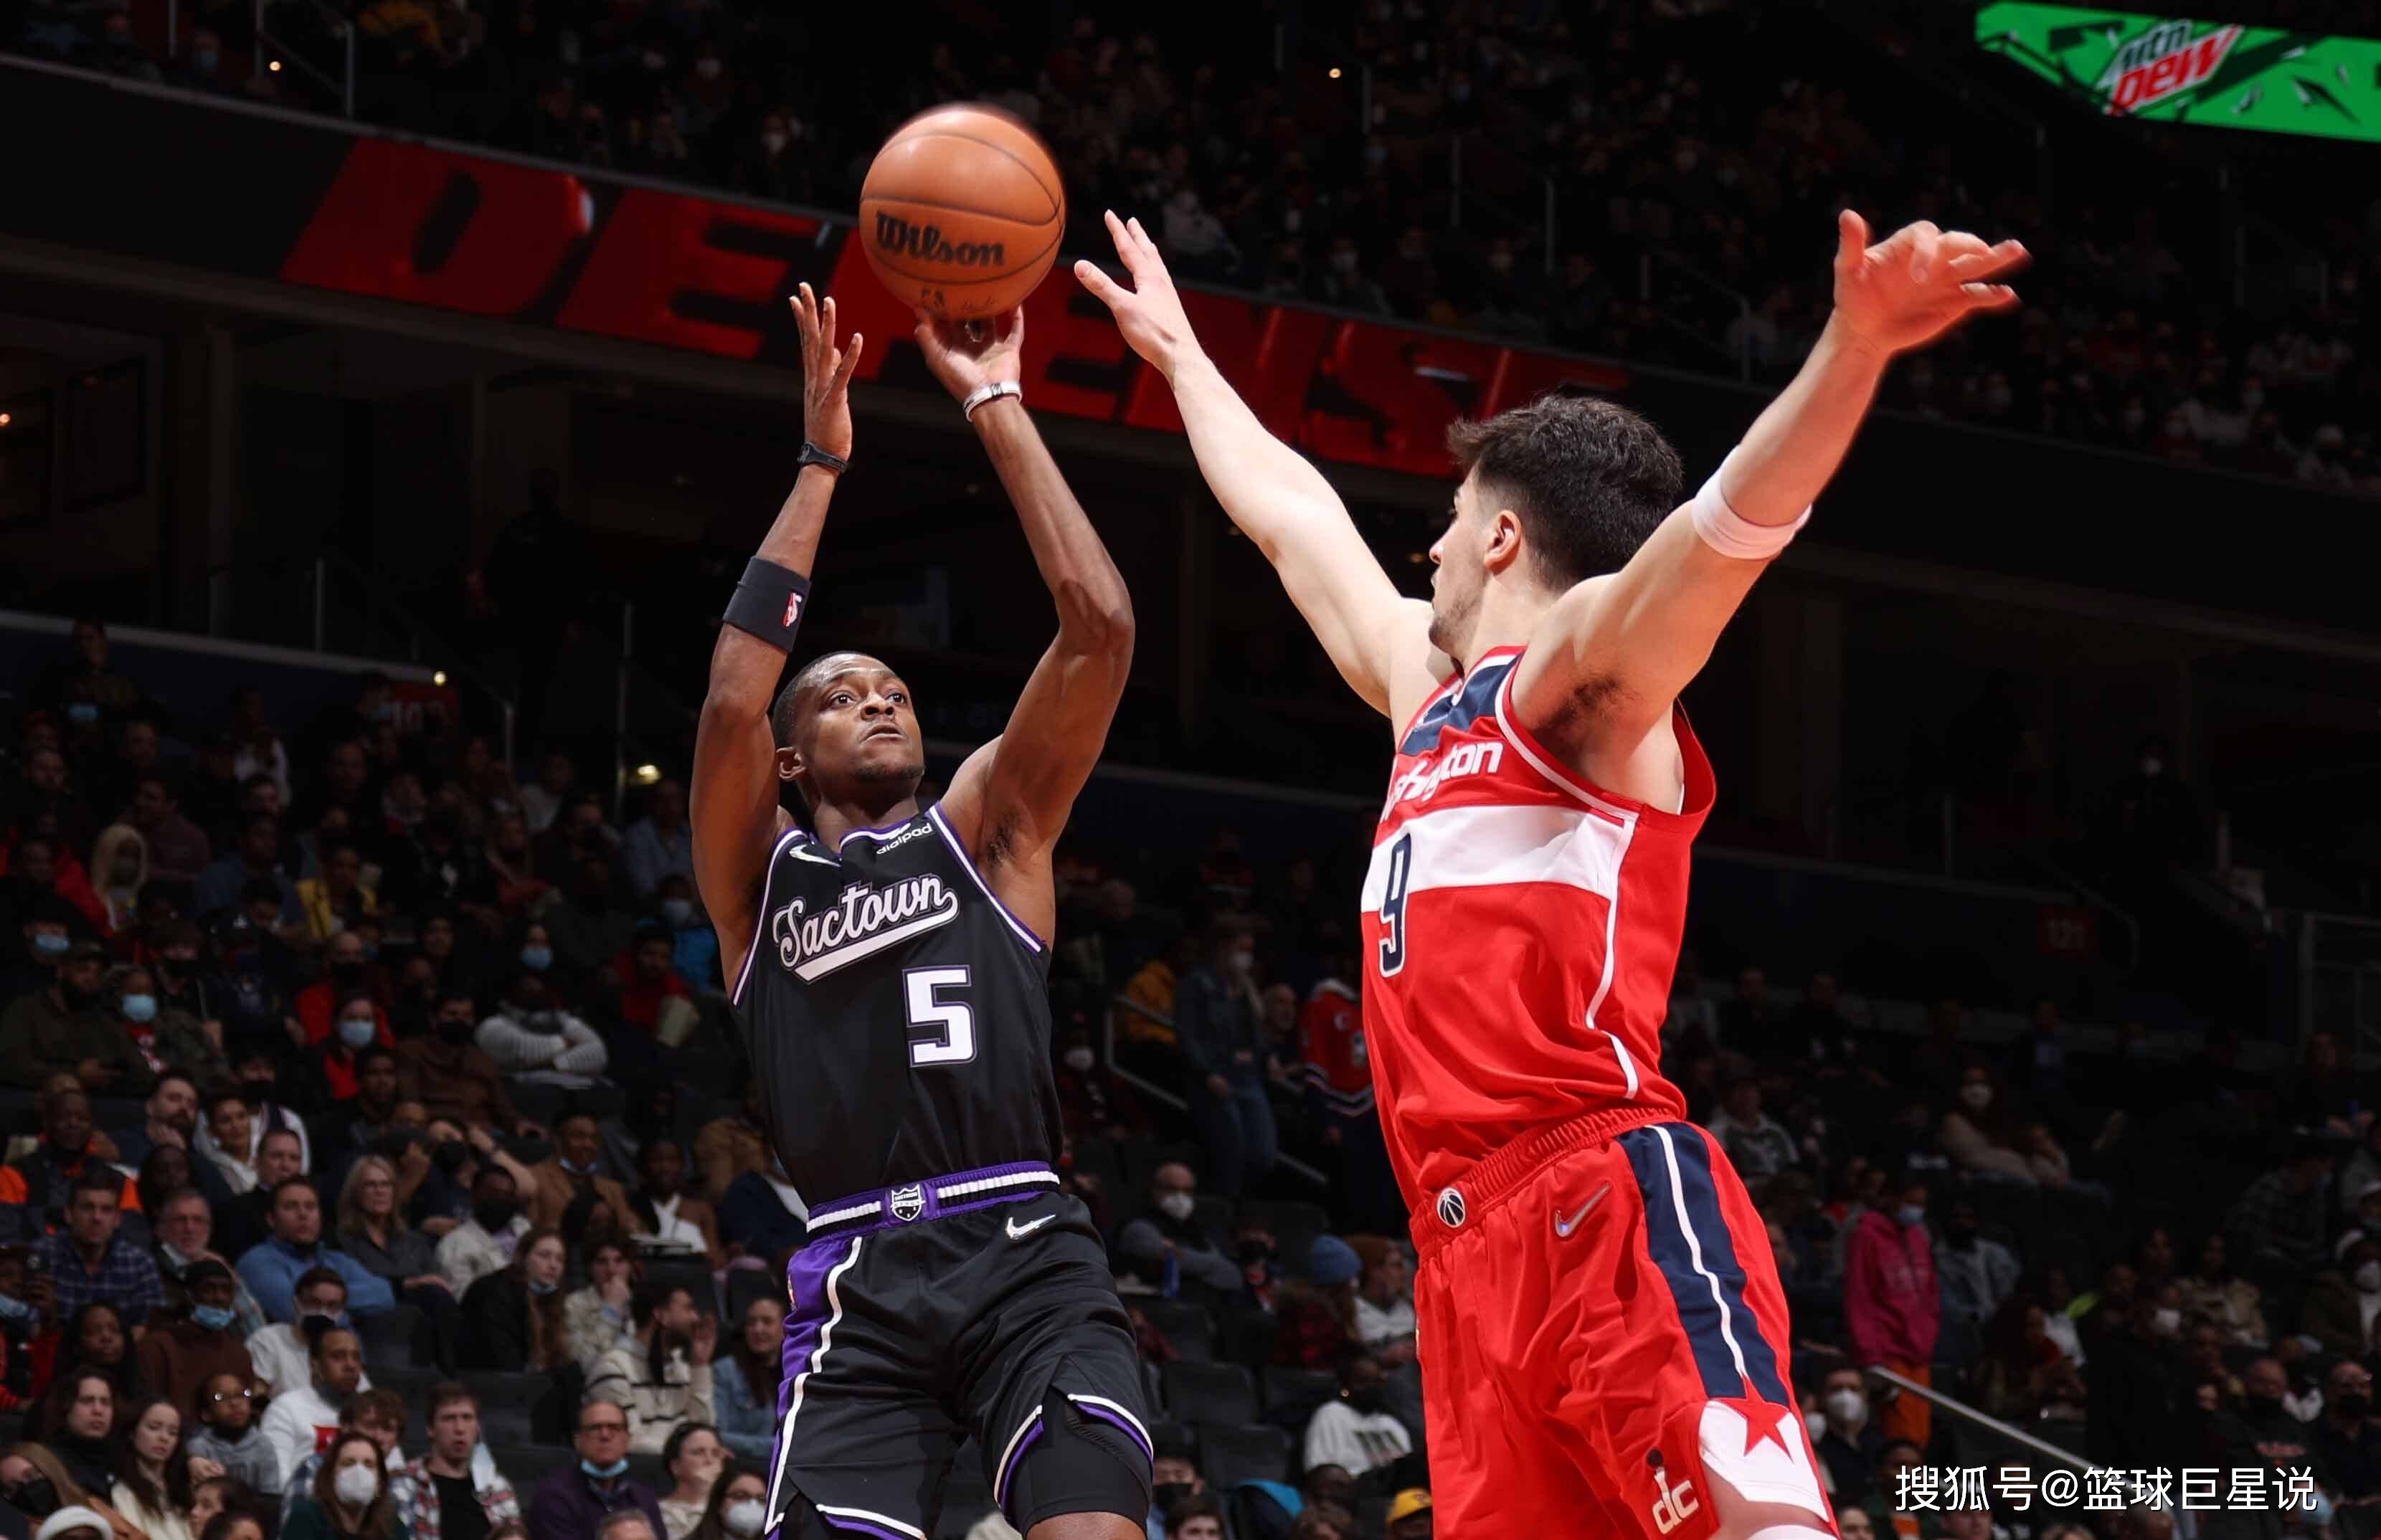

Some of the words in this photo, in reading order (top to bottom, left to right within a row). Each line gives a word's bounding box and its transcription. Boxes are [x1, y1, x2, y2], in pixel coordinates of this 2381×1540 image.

[876, 210, 1005, 265] Wilson
[876, 822, 932, 855] dialpad
[772, 873, 958, 971] Sactown
[1380, 832, 1413, 976] 9
[902, 964, 977, 1068] 5
[1652, 1466, 1699, 1534] dc
